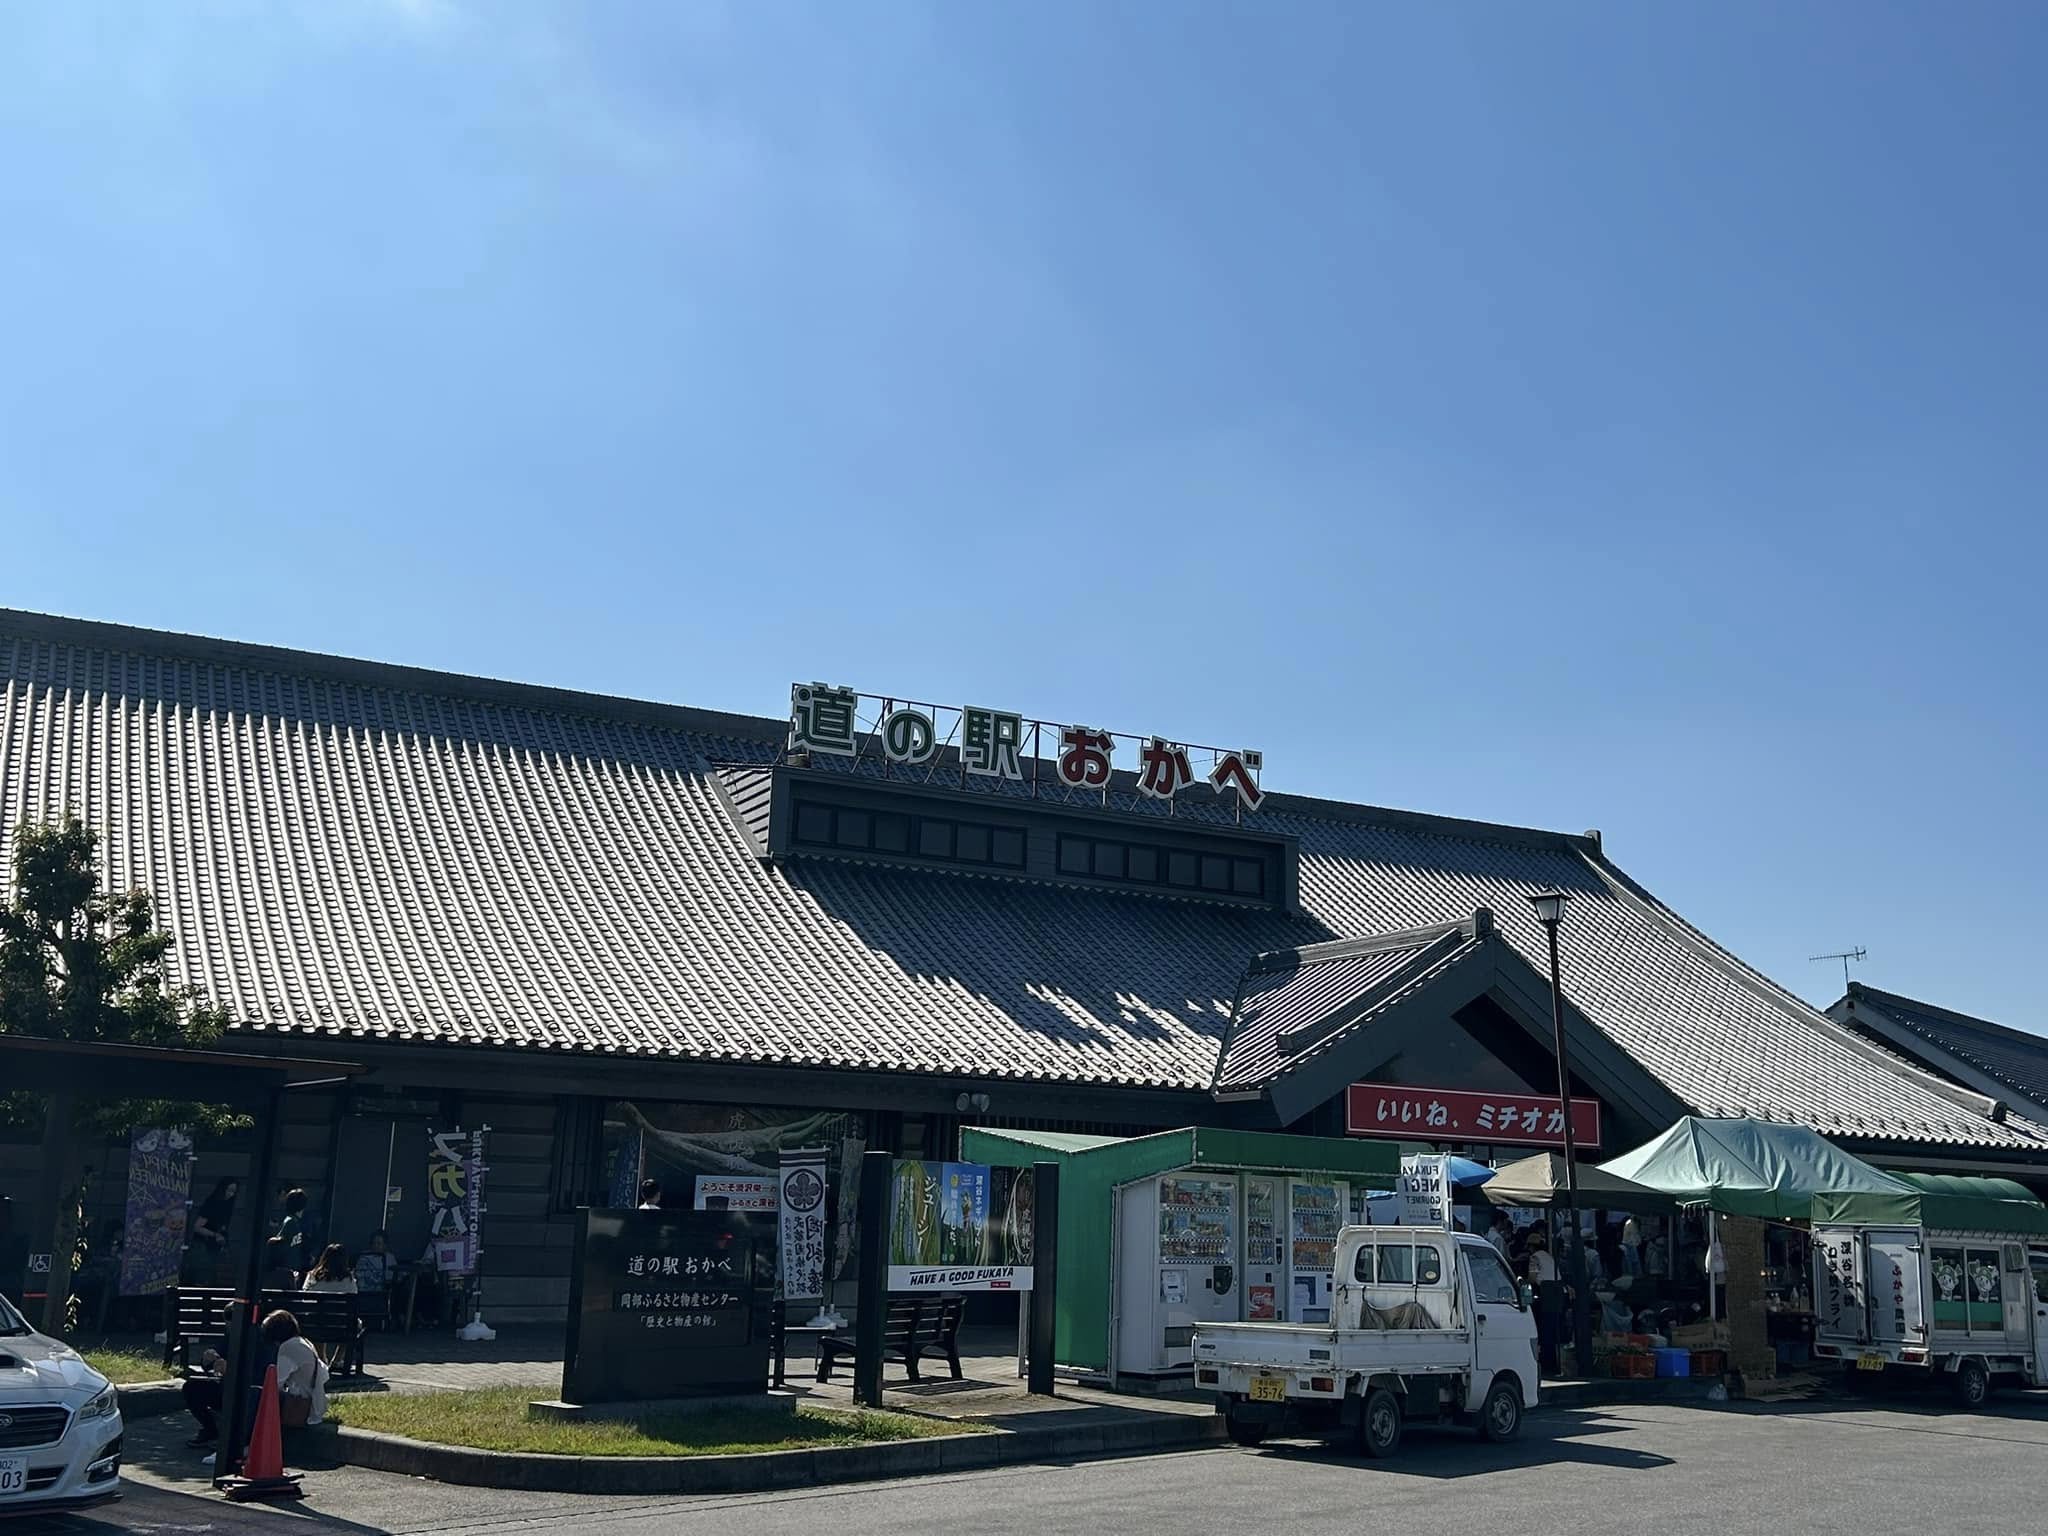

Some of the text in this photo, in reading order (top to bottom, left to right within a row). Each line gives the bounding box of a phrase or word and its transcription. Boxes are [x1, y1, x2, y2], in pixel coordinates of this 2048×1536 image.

[789, 681, 1265, 811] 道の駅おかべ
[917, 1176, 937, 1254] ジューシー
[627, 1255, 732, 1277] 道の駅おかべ
[910, 1267, 1014, 1286] HAVE A GOOD FUKAYA
[620, 1293, 740, 1309] 岡部ふるさと物産センター
